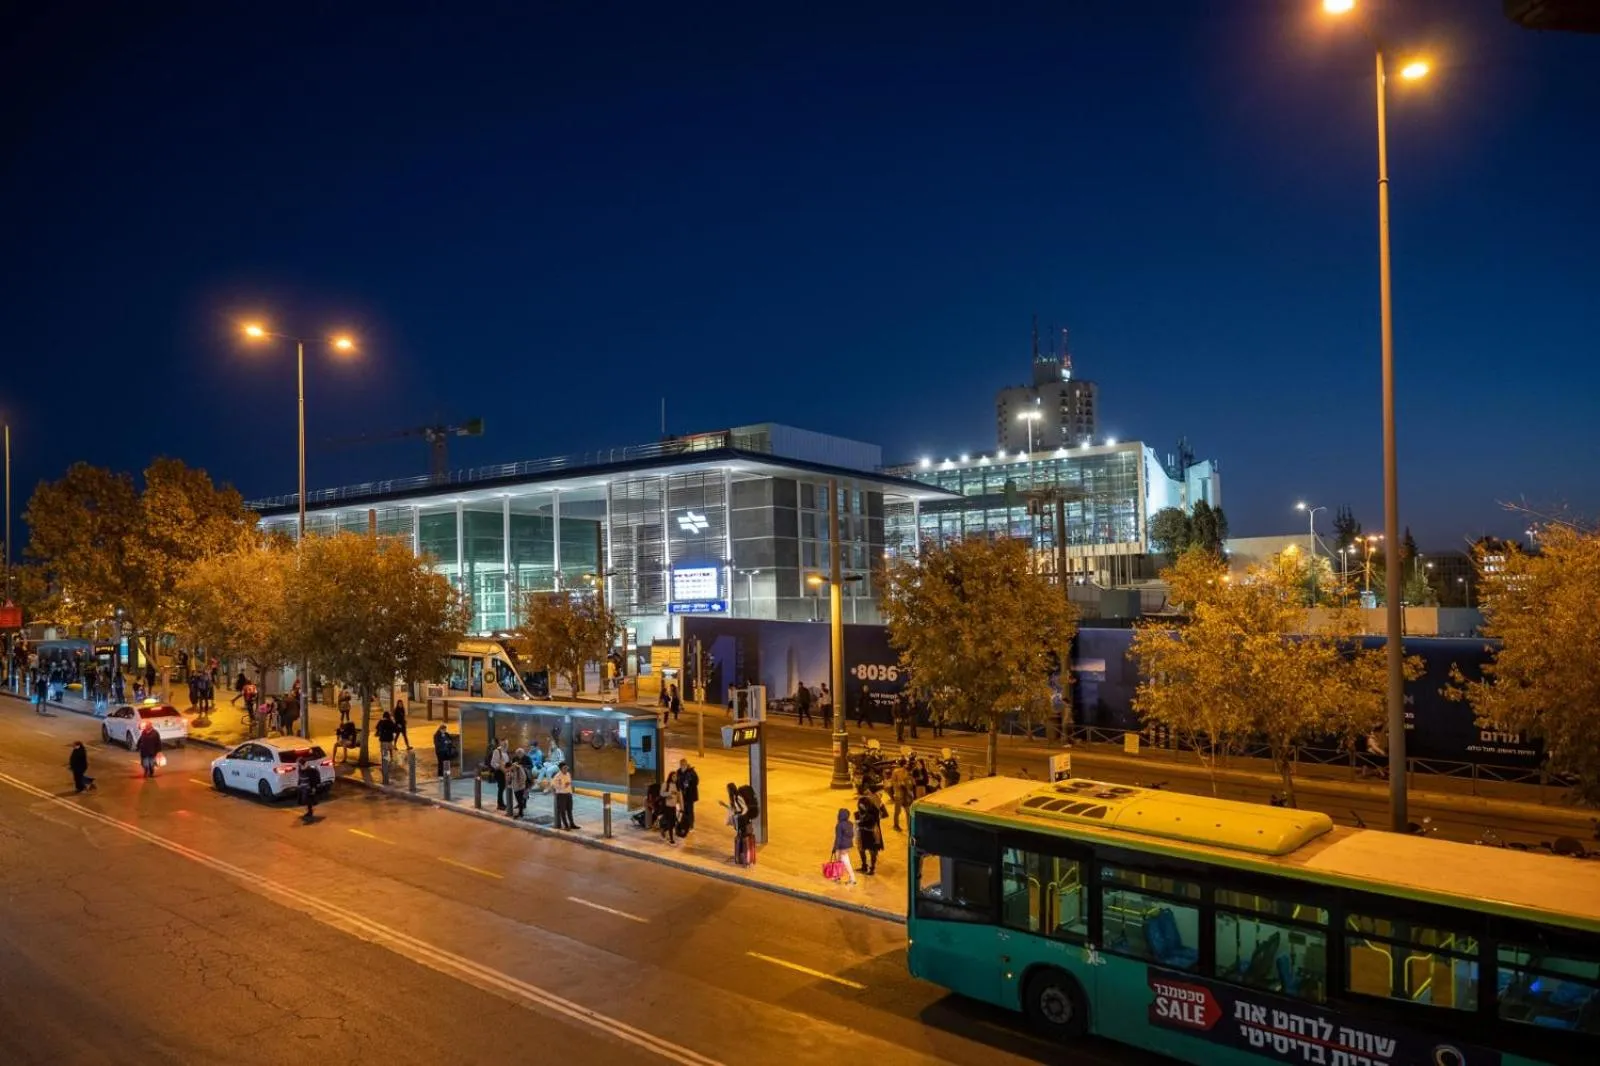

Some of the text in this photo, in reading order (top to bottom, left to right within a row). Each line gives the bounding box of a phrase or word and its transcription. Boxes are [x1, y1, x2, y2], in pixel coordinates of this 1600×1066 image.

[1153, 983, 1205, 1004] ספטמבר
[1155, 997, 1206, 1025] SALE
[1233, 1000, 1397, 1058] שווה לרהט את
[1239, 1024, 1327, 1065] בדיסיטי
